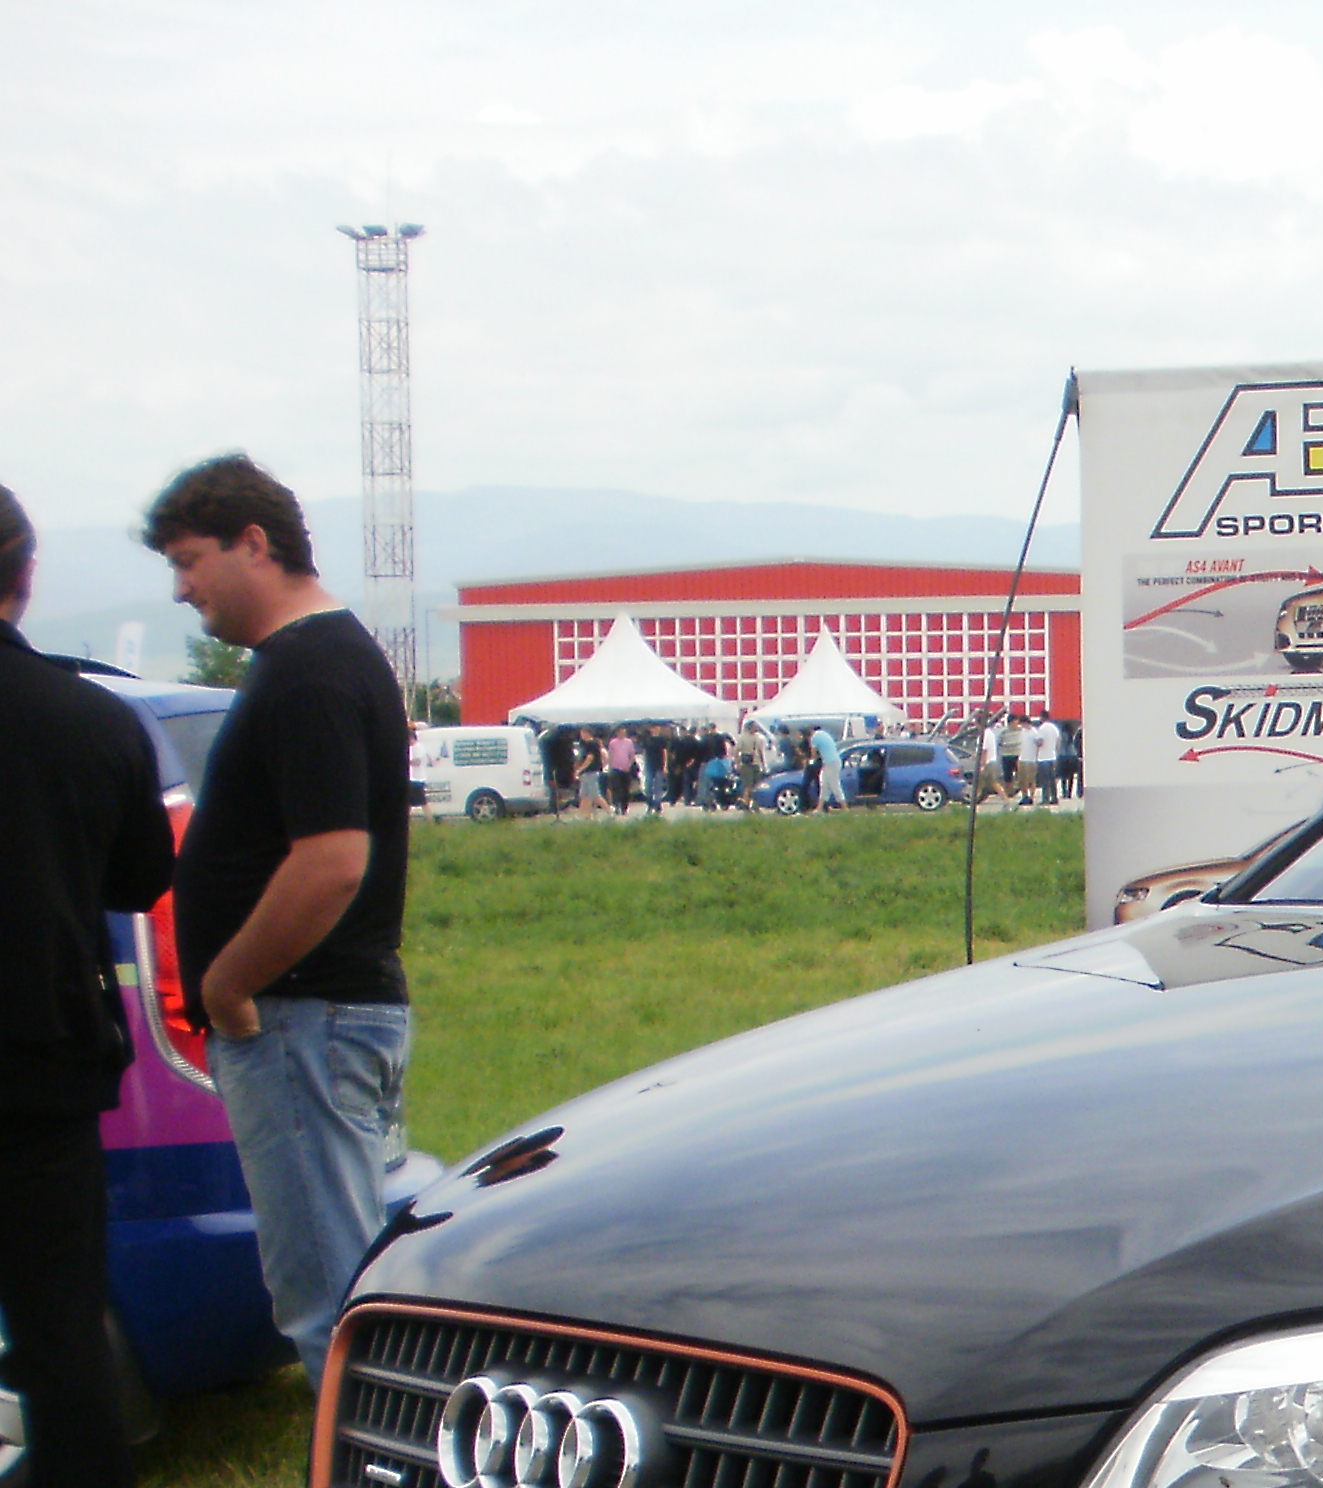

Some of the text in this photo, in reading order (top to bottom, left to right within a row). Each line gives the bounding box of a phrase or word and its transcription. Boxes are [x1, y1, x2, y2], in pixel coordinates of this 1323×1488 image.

[1209, 558, 1245, 573] AVANT
[1137, 576, 1150, 587] THE
[1153, 575, 1185, 587] PERFECT
